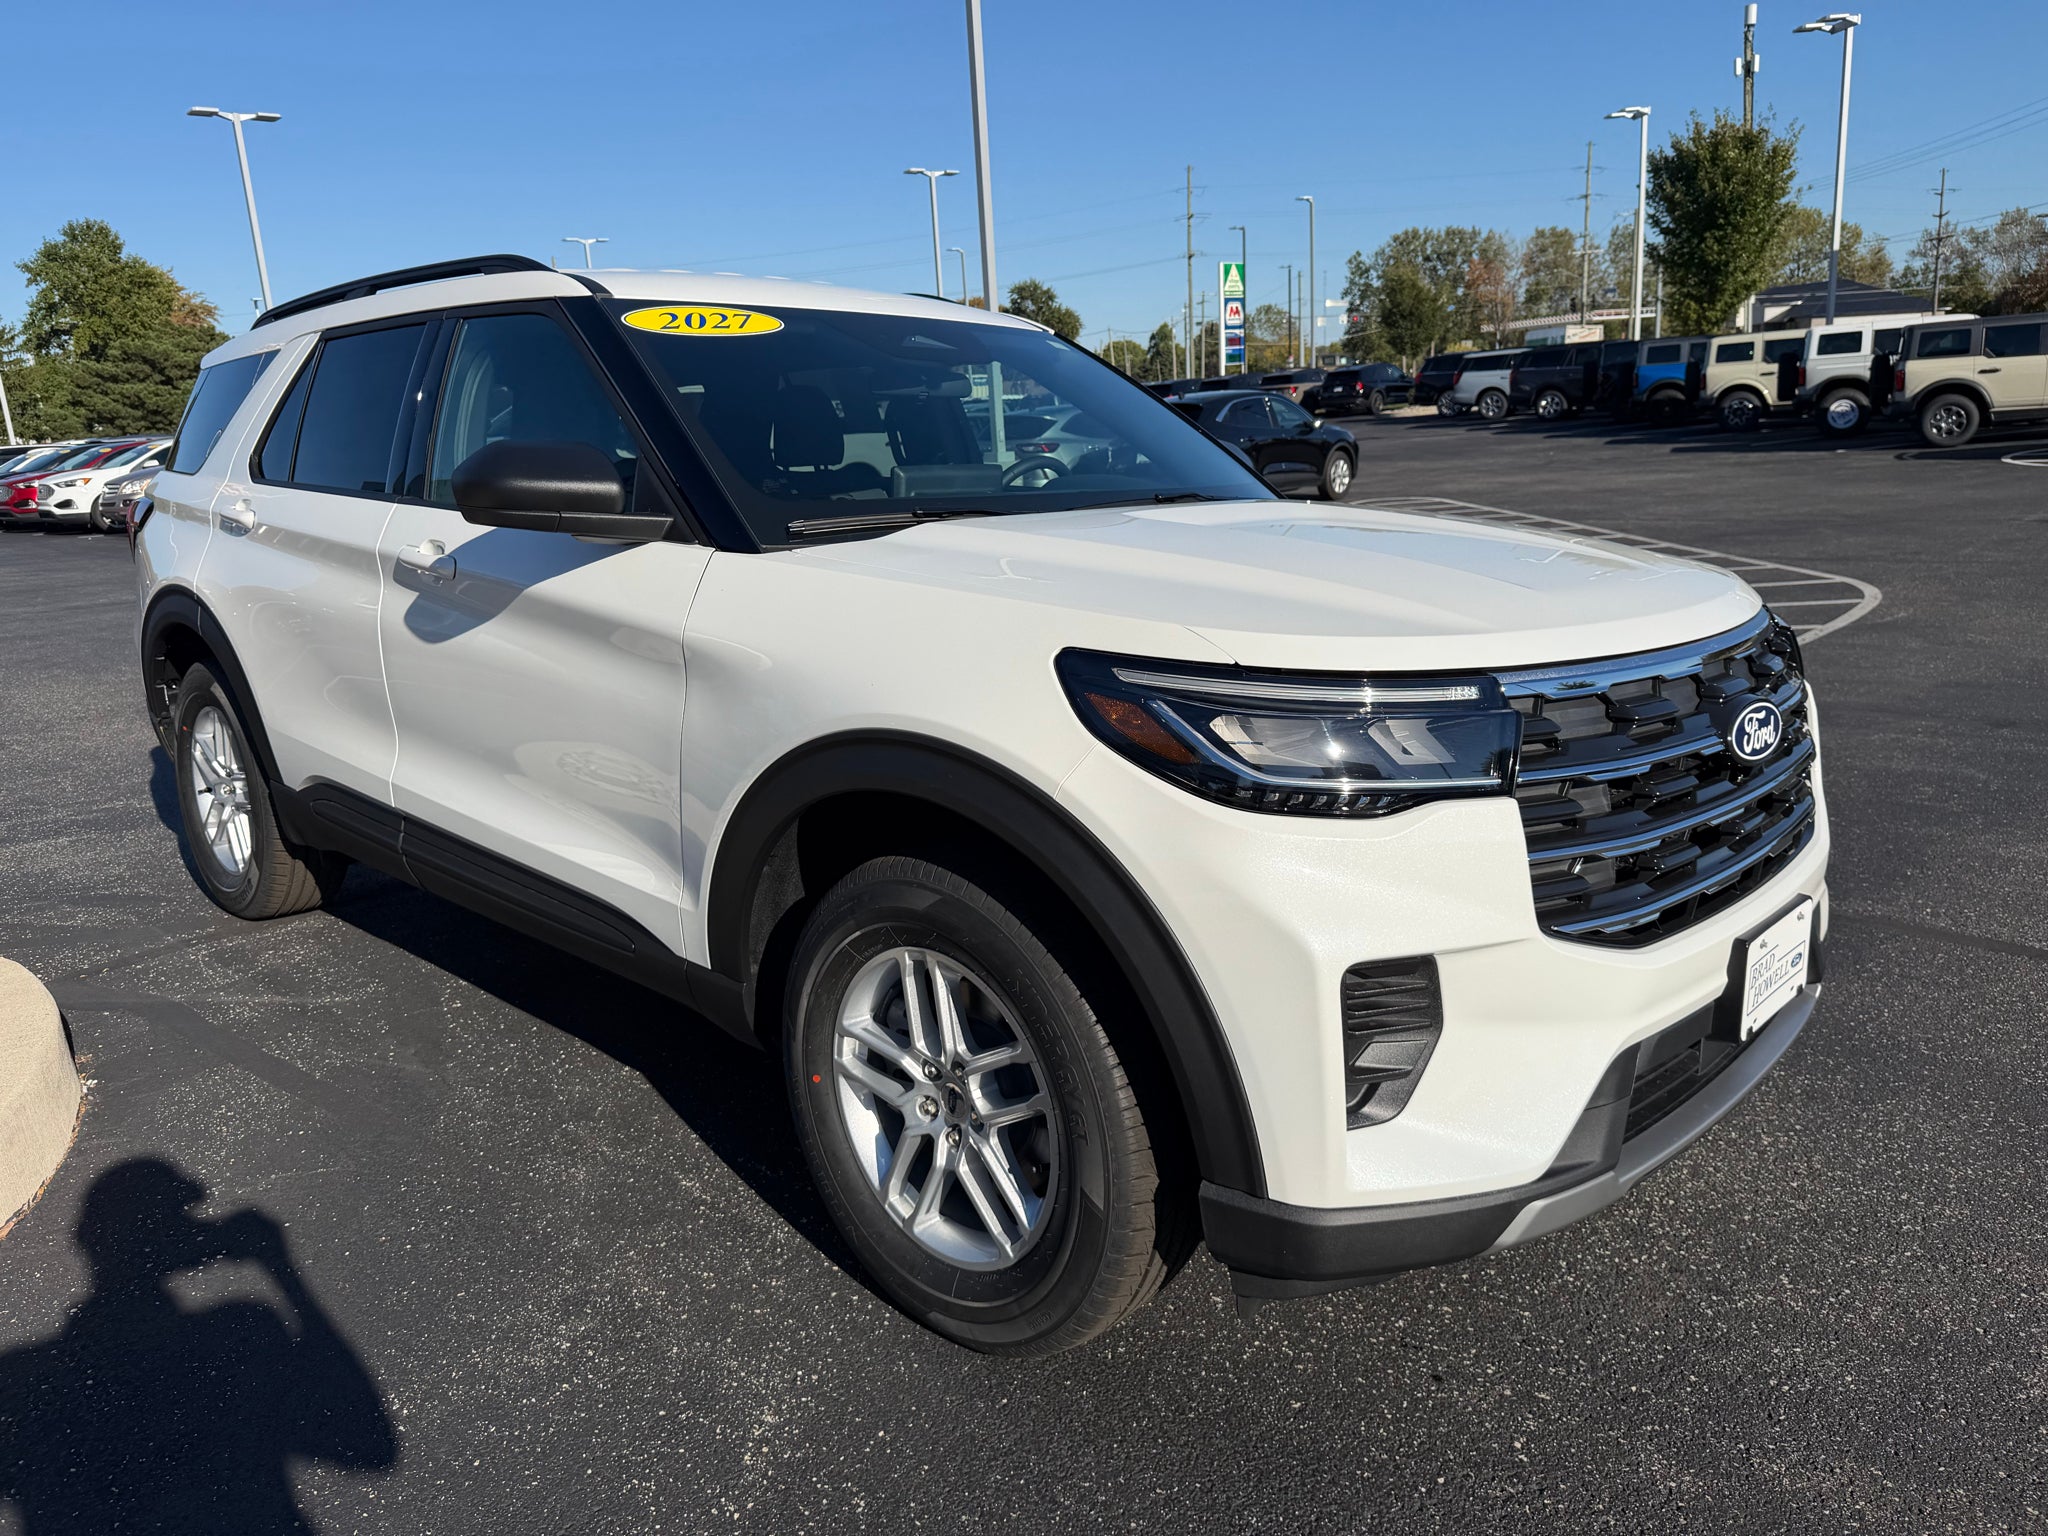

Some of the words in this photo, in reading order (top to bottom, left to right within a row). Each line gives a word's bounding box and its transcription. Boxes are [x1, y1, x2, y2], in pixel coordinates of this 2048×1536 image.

[658, 312, 752, 330] 2027
[1743, 709, 1776, 754] Ford
[1750, 952, 1776, 989] BRAD
[1752, 960, 1790, 1008] HOWELL
